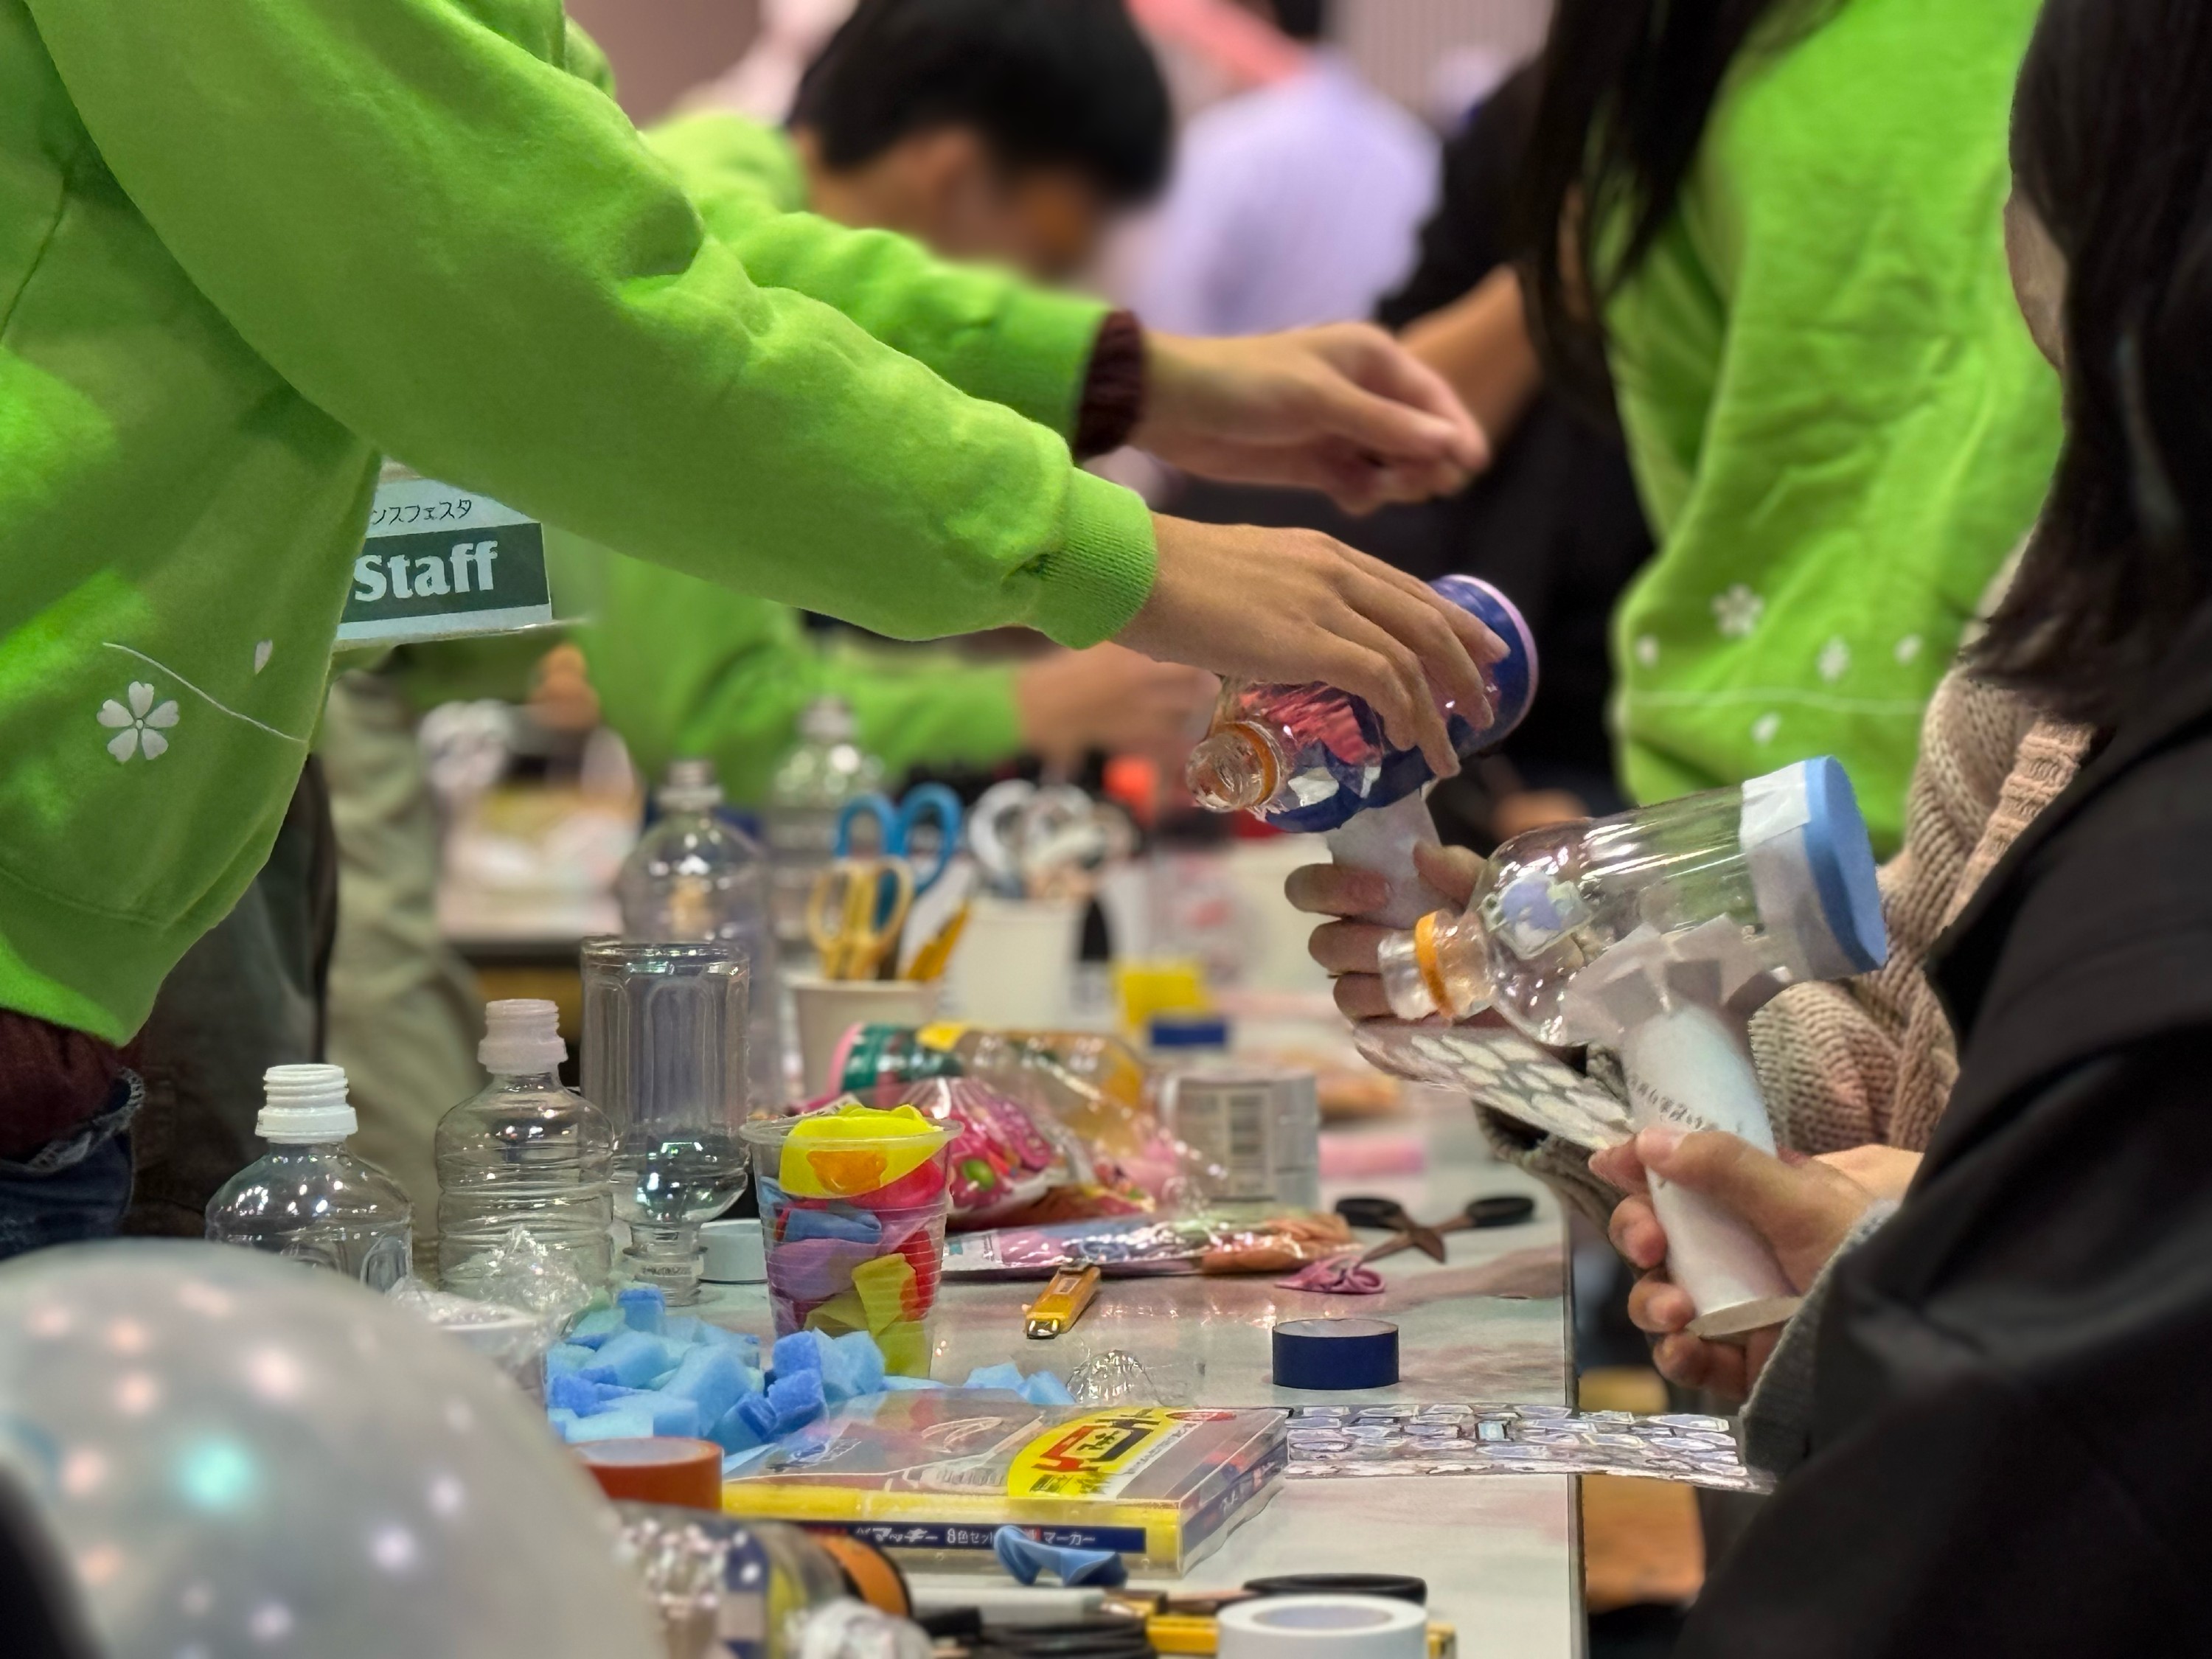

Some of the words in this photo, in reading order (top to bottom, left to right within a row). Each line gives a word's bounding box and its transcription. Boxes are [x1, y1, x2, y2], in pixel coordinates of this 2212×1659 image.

[372, 498, 472, 526] ンスフェスタ
[353, 540, 498, 602] Staff
[1043, 1531, 1096, 1545] マーカー
